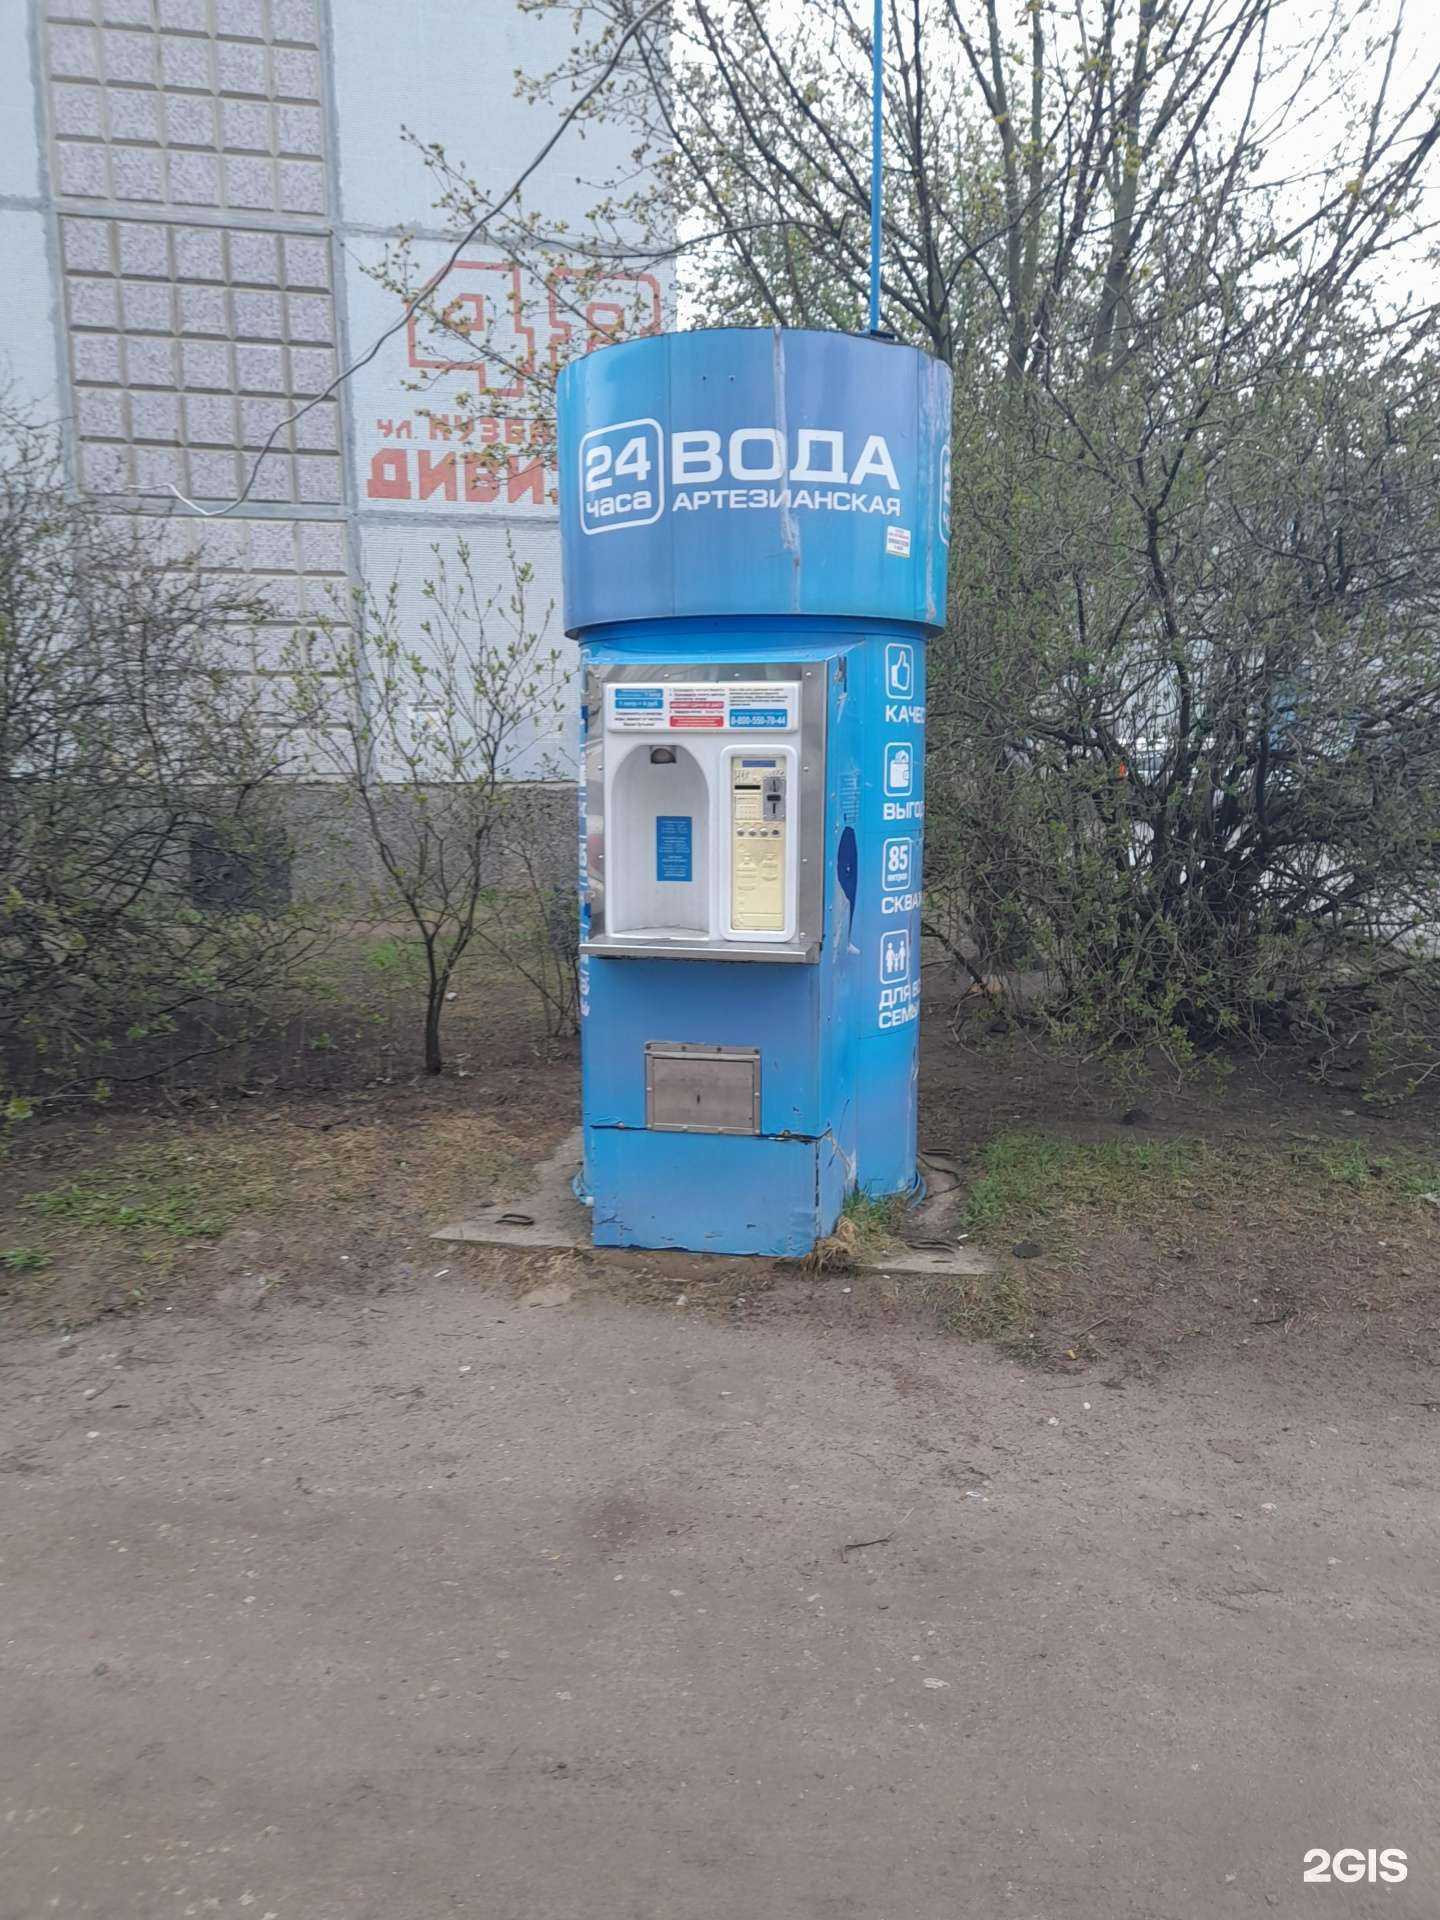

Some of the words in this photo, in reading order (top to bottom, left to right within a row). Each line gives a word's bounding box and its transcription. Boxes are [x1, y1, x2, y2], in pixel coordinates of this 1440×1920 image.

[586, 436, 651, 492] 24
[671, 428, 900, 490] ВОДА
[367, 447, 559, 506] ДИВИ
[586, 490, 652, 518] часа
[672, 488, 901, 517] АРТЕЗИАНСКАЯ
[888, 844, 909, 873] 85
[879, 983, 911, 1011] ДЛЯ
